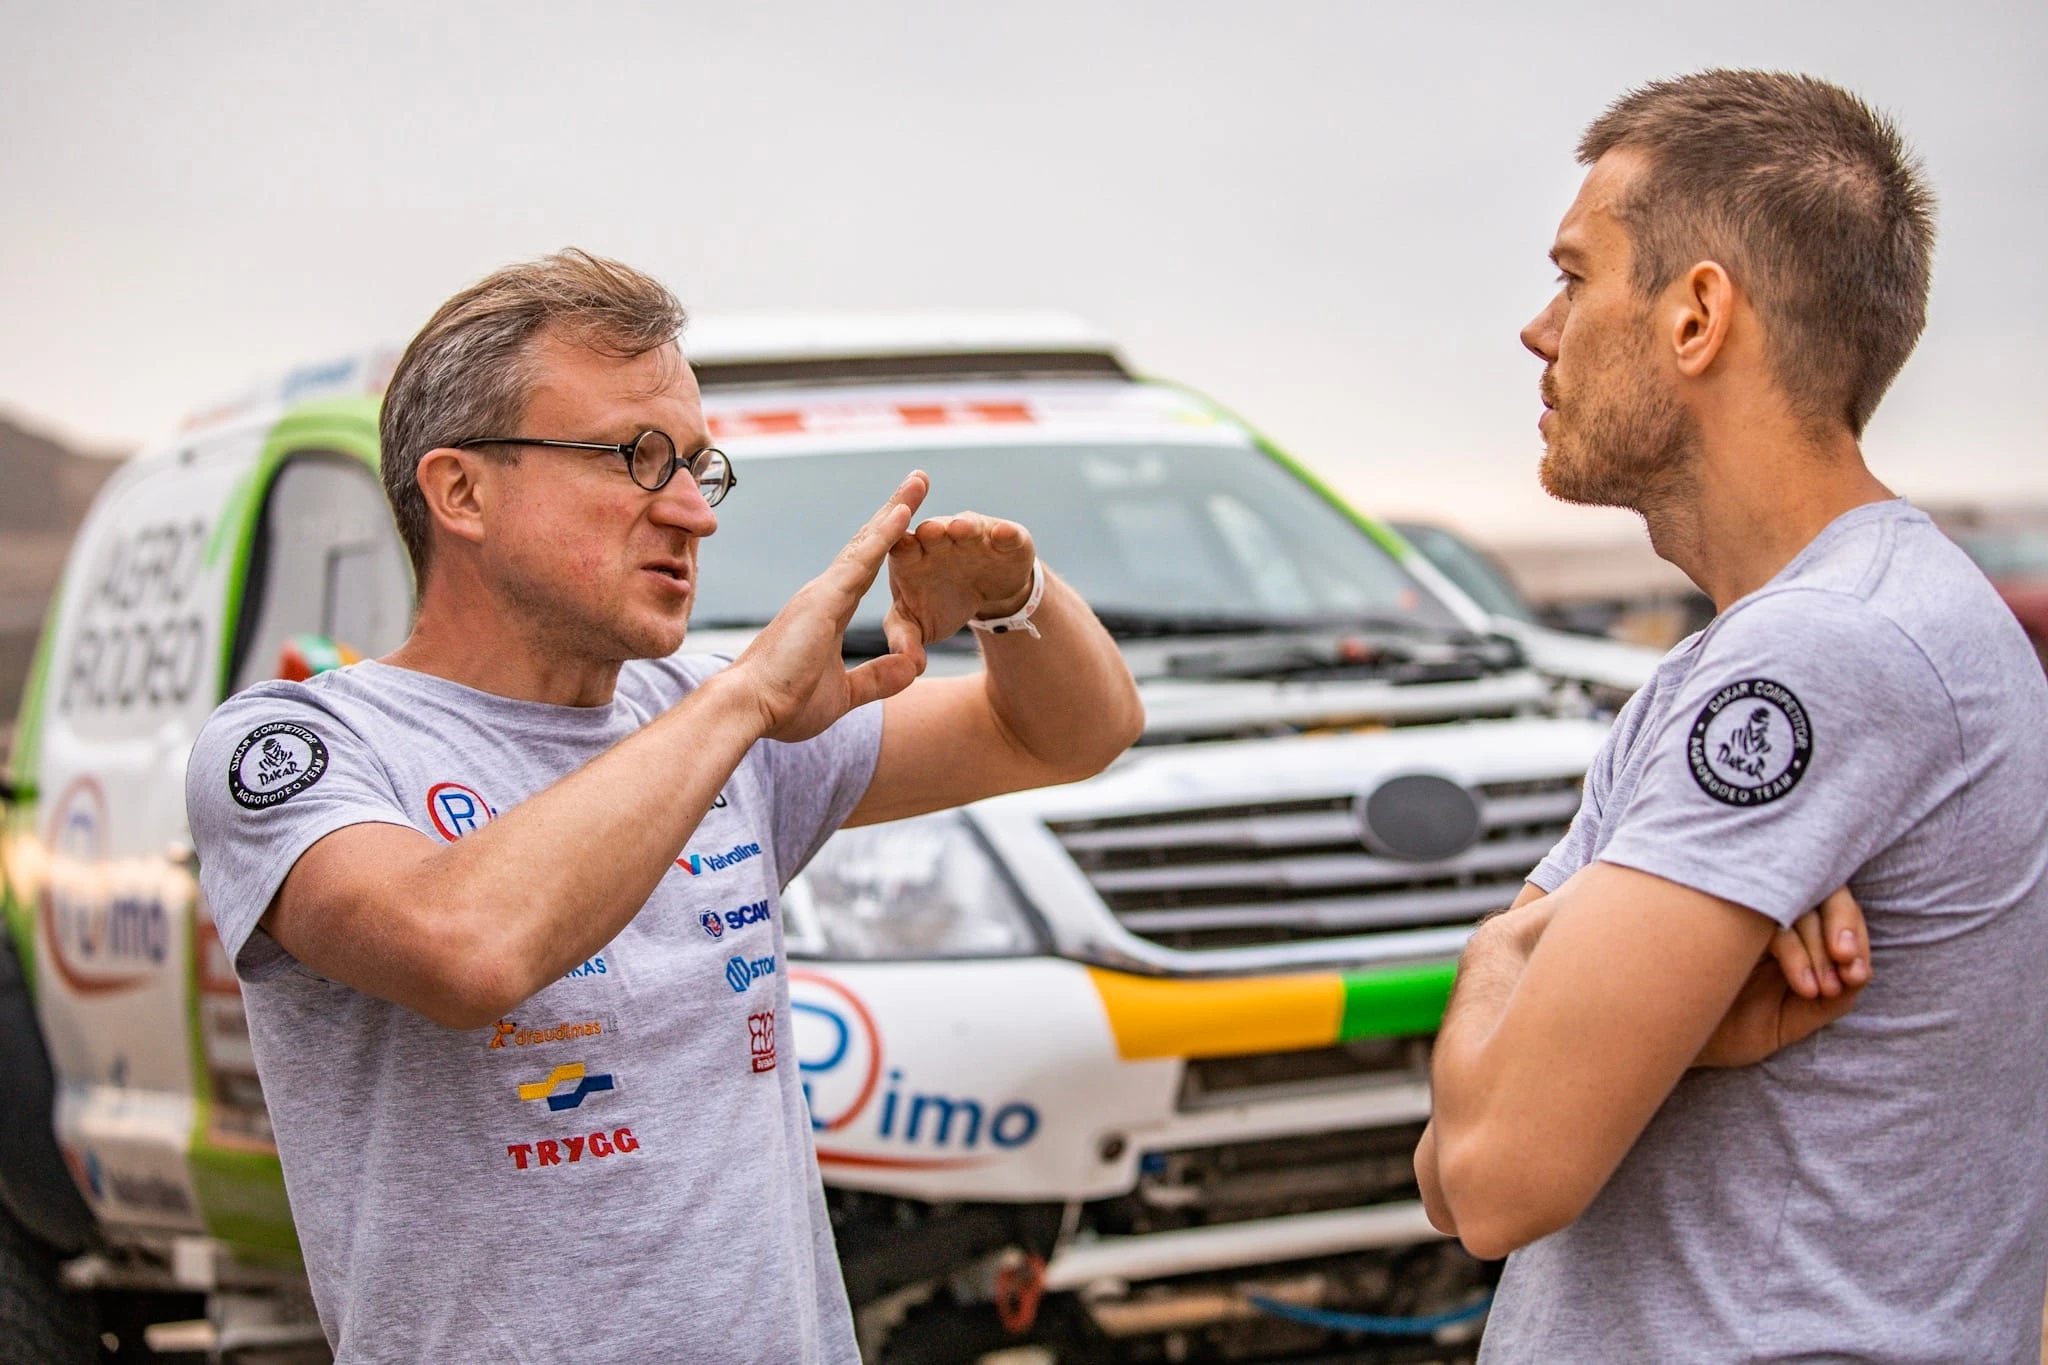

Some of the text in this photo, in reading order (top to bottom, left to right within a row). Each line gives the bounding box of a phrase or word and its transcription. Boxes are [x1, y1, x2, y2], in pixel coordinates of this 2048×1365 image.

[1709, 681, 1808, 749] DAKAR COMPETITOR
[231, 724, 317, 771] DAKAR COMPETITOR
[1690, 737, 1792, 802] AGRORODEO TEAM
[1716, 743, 1766, 783] DAKAR
[237, 758, 324, 804] AGRORODEO TEAM
[258, 761, 302, 786] DAKAR
[702, 842, 762, 872] Valvoline
[507, 1128, 640, 1170] TRYGG
